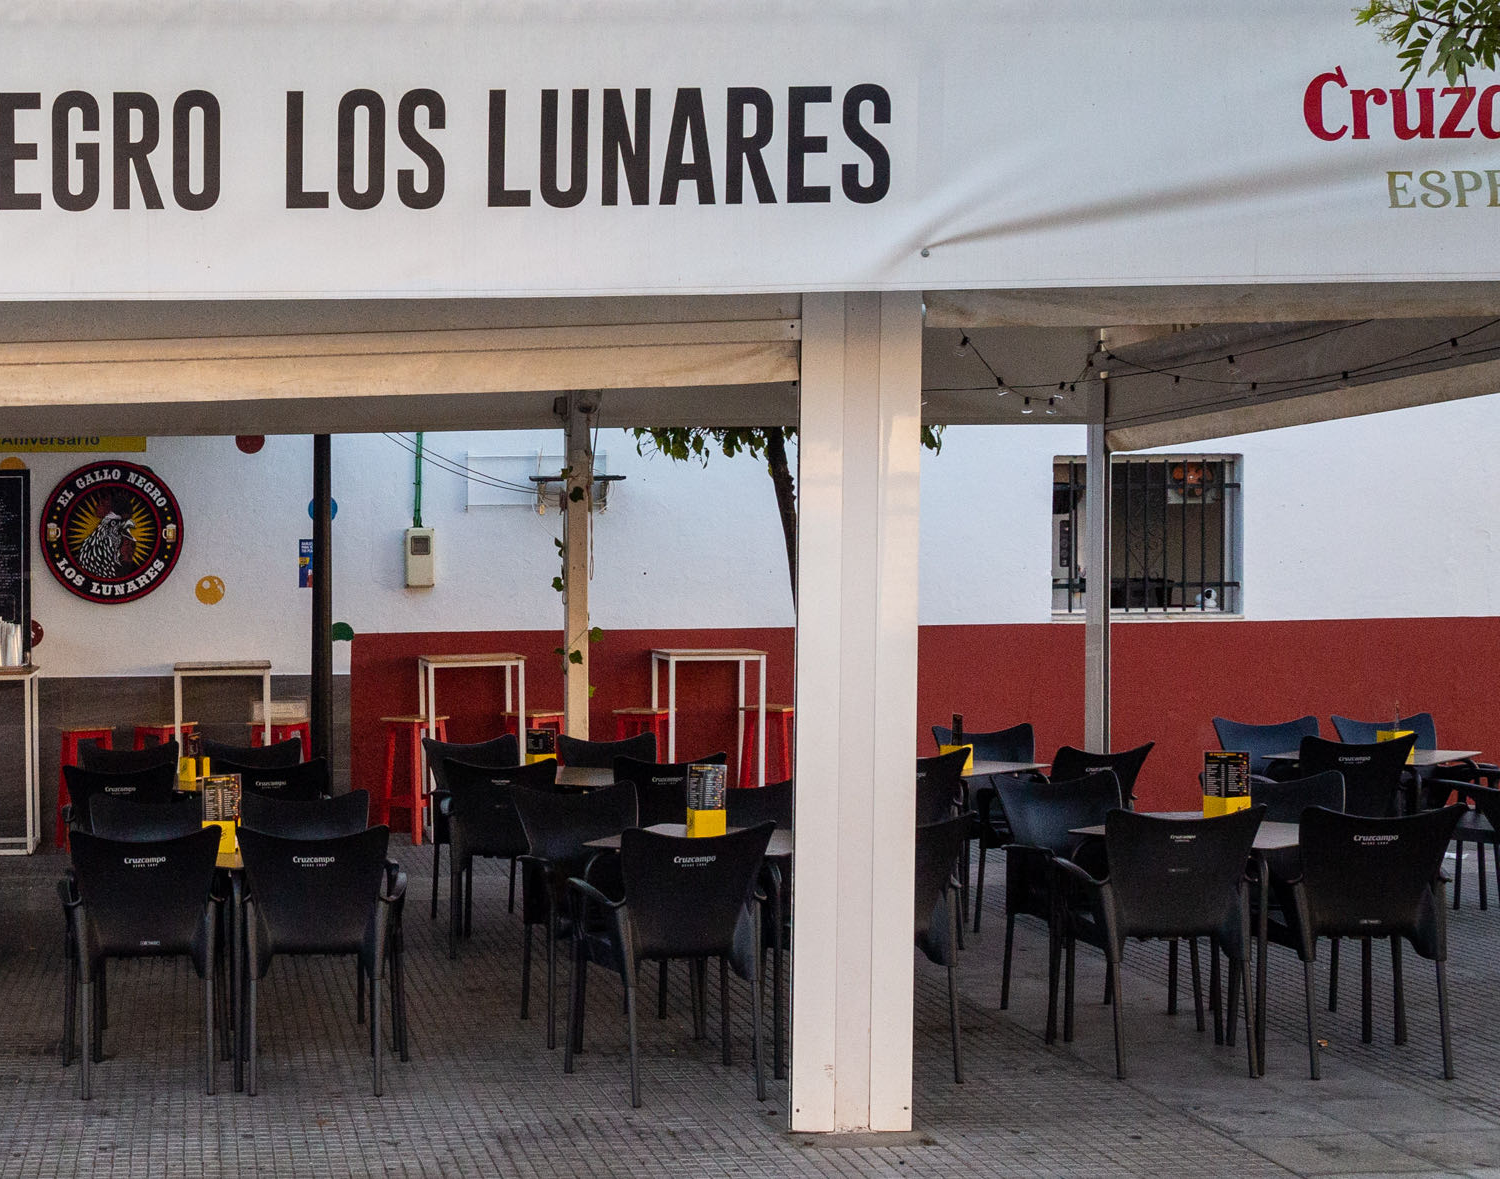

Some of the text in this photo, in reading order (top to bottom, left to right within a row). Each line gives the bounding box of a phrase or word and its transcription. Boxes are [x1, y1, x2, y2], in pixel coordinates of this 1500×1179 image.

[286, 88, 446, 210] LOS
[487, 83, 891, 209] LUNARES
[56, 468, 168, 507] EL GALLO NEGRO
[56, 557, 166, 597] LOS LUNARES
[1353, 834, 1399, 842] Cruzcampo
[123, 855, 166, 864] Cruzcampo
[292, 855, 335, 864] Cruzcampo
[673, 855, 717, 864] Cruzcampo
